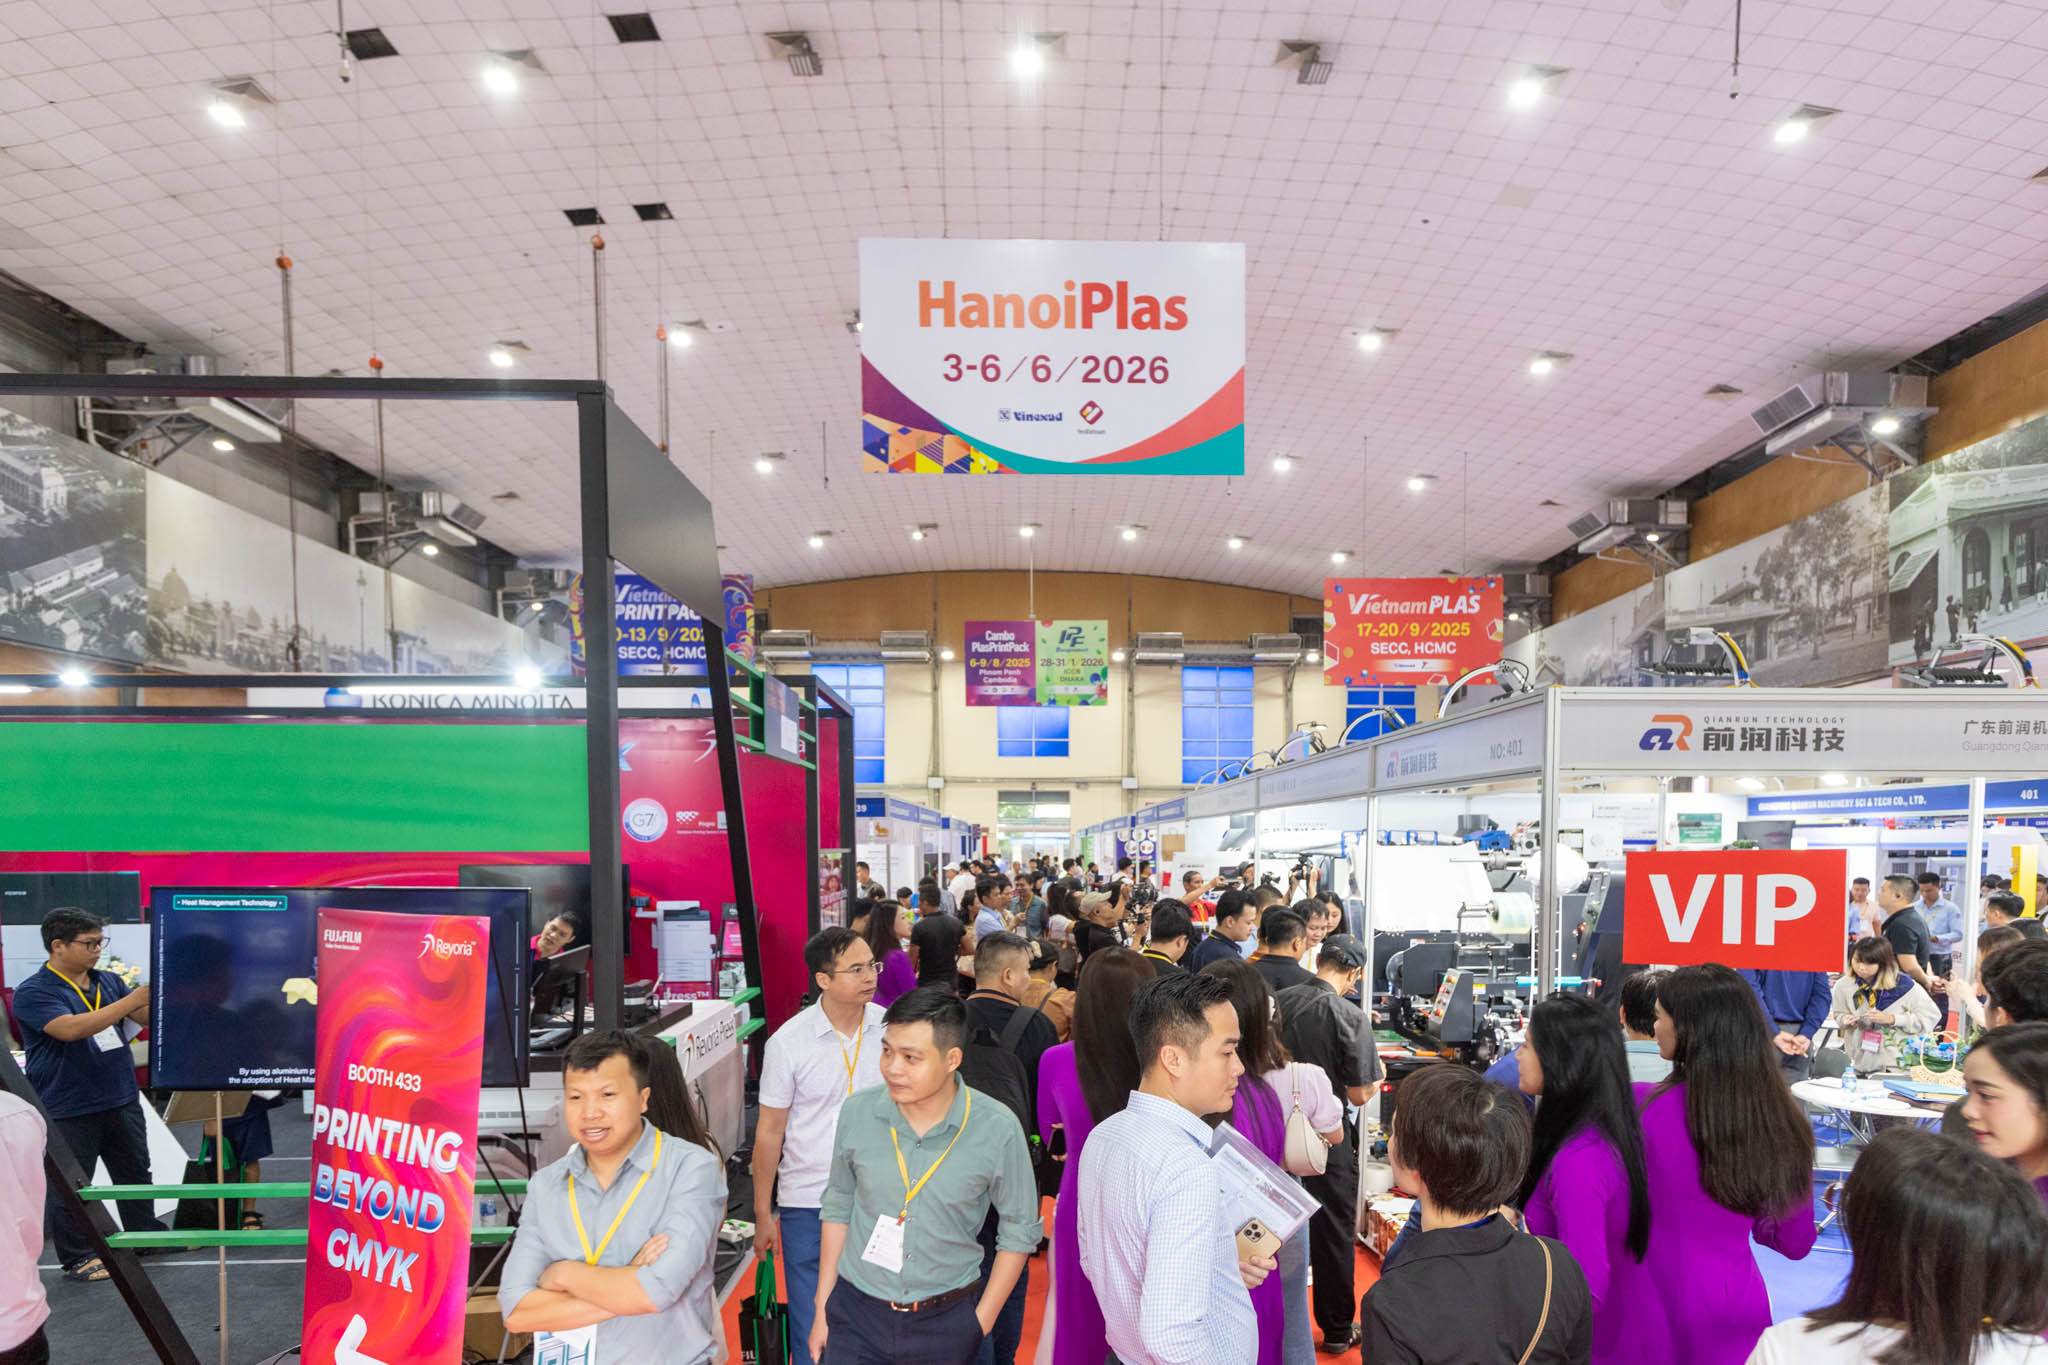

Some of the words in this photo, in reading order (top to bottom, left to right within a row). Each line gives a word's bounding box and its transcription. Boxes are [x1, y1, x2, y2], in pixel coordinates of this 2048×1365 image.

[918, 280, 1188, 331] HanoiPlas
[1357, 621, 1471, 637] 17-20/9/2025
[618, 646, 660, 660] SECC,
[1370, 642, 1411, 655] SECC,
[1414, 642, 1457, 654] HCMC
[372, 694, 463, 709] KONICA
[1703, 716, 1758, 724] QIANRUN
[1703, 727, 1845, 752] 前润科技
[1874, 797, 1892, 807] TECH
[2020, 789, 2039, 800] 401
[1648, 873, 1816, 946] VIP
[239, 1068, 249, 1076] By
[250, 1068, 270, 1076] using
[348, 1064, 394, 1088] BOOTH
[395, 1072, 421, 1092] 433
[242, 1077, 273, 1085] adoption
[312, 1104, 463, 1173] PRINTING
[314, 1163, 445, 1234] BEYOND
[327, 1228, 419, 1293] CMYK
